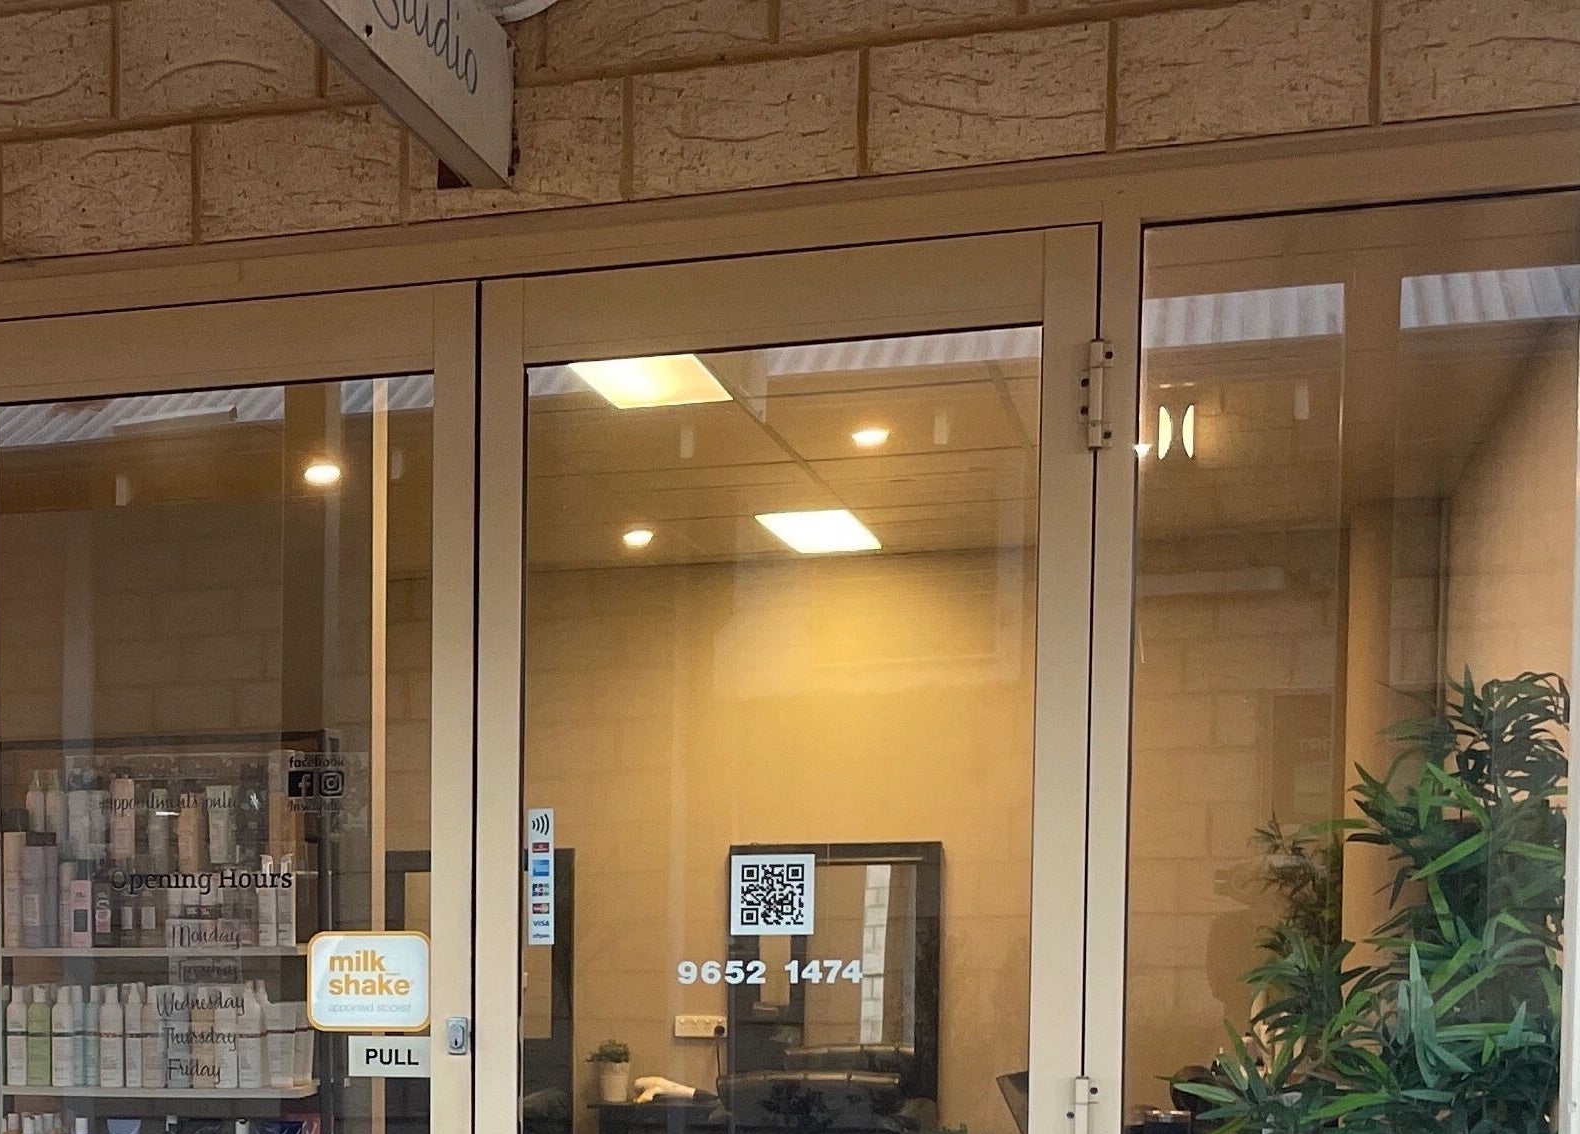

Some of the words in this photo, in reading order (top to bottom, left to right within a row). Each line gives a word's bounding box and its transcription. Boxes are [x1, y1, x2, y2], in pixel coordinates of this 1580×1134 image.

[373, 0, 478, 95] udio
[288, 755, 345, 768] facebook
[100, 790, 198, 816] Appotmnts
[111, 870, 213, 895] Opening
[219, 867, 293, 889] Hours
[171, 924, 240, 949] Monday
[328, 973, 410, 996] shake
[677, 960, 767, 985] 9652
[784, 959, 863, 984] 1474
[156, 990, 245, 1018] Wednesday
[162, 1026, 238, 1051] Thursday
[365, 1048, 420, 1066] PULL
[167, 1057, 221, 1084] Friday
